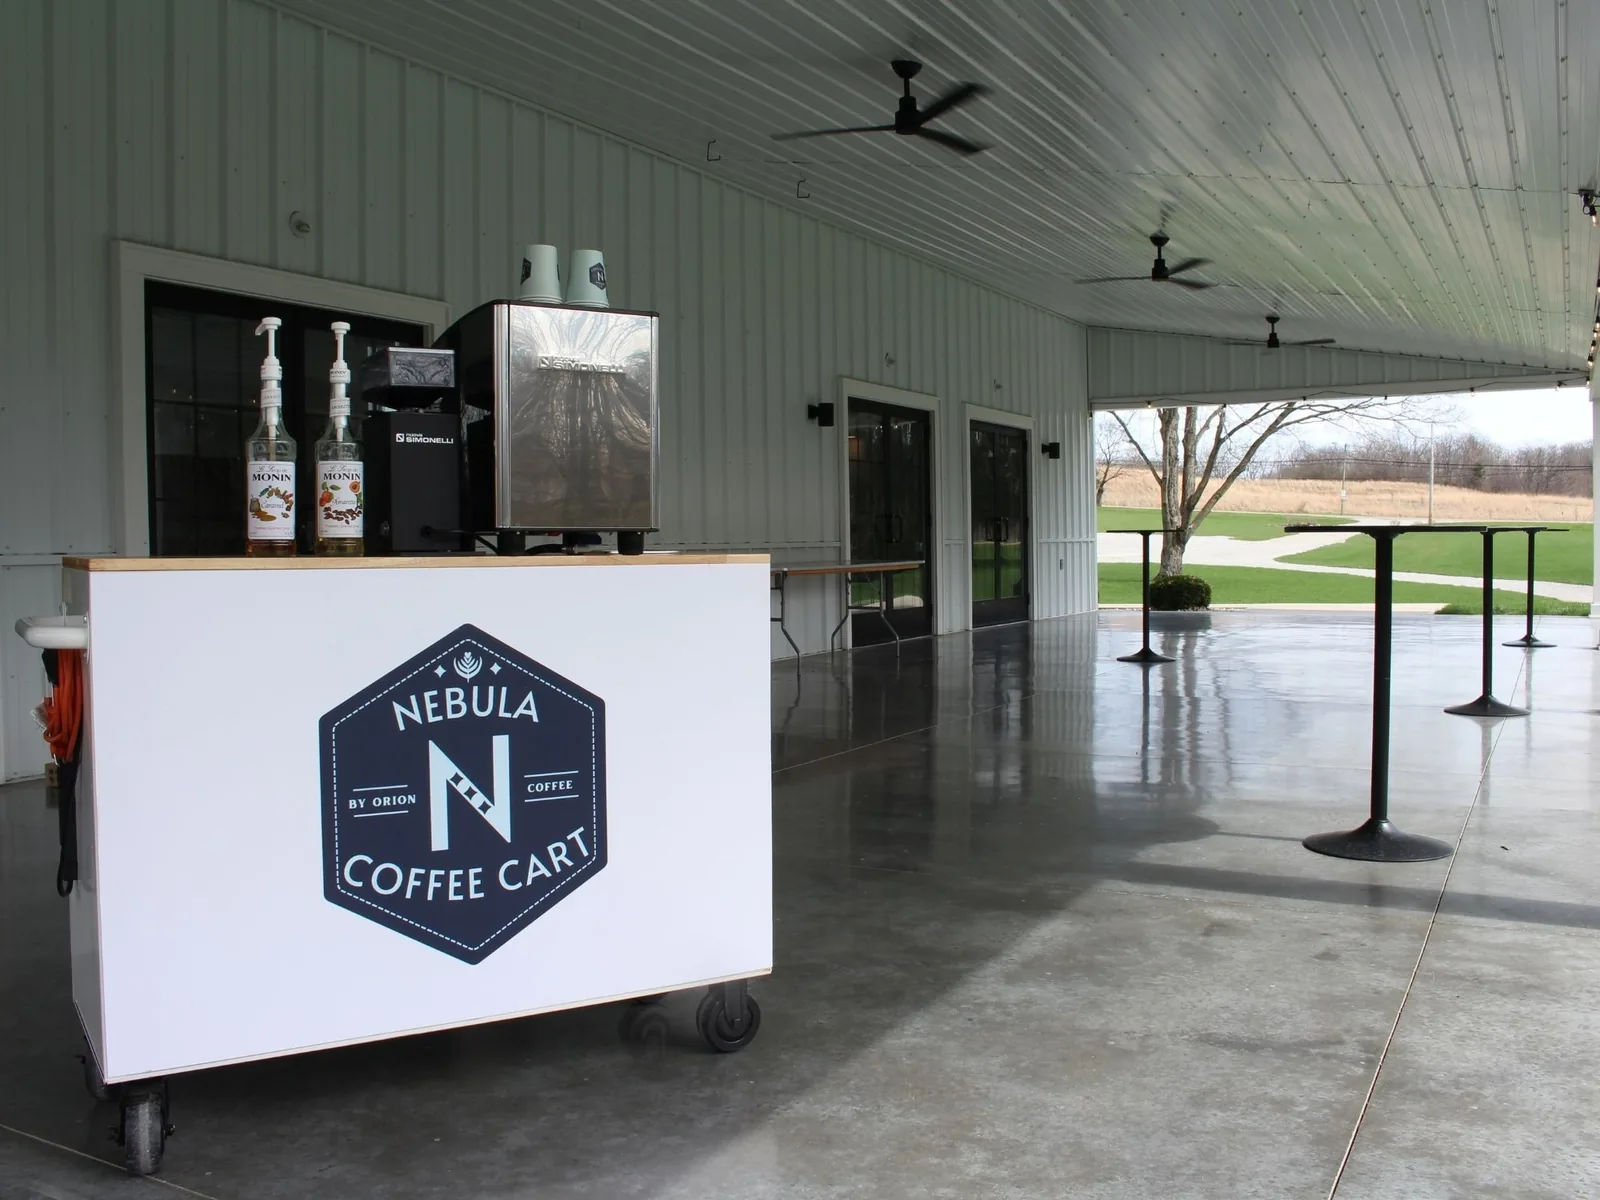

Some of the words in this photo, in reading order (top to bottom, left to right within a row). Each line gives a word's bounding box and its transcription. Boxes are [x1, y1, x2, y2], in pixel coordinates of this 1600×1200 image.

[252, 473, 292, 482] MONIN
[323, 472, 361, 481] MONIN
[392, 685, 539, 732] NEBULA
[428, 734, 511, 852] N
[527, 780, 574, 793] COFFEE
[349, 799, 365, 810] BY
[372, 793, 417, 807] ORION
[343, 854, 485, 901] COFFEE
[498, 826, 589, 891] CART
